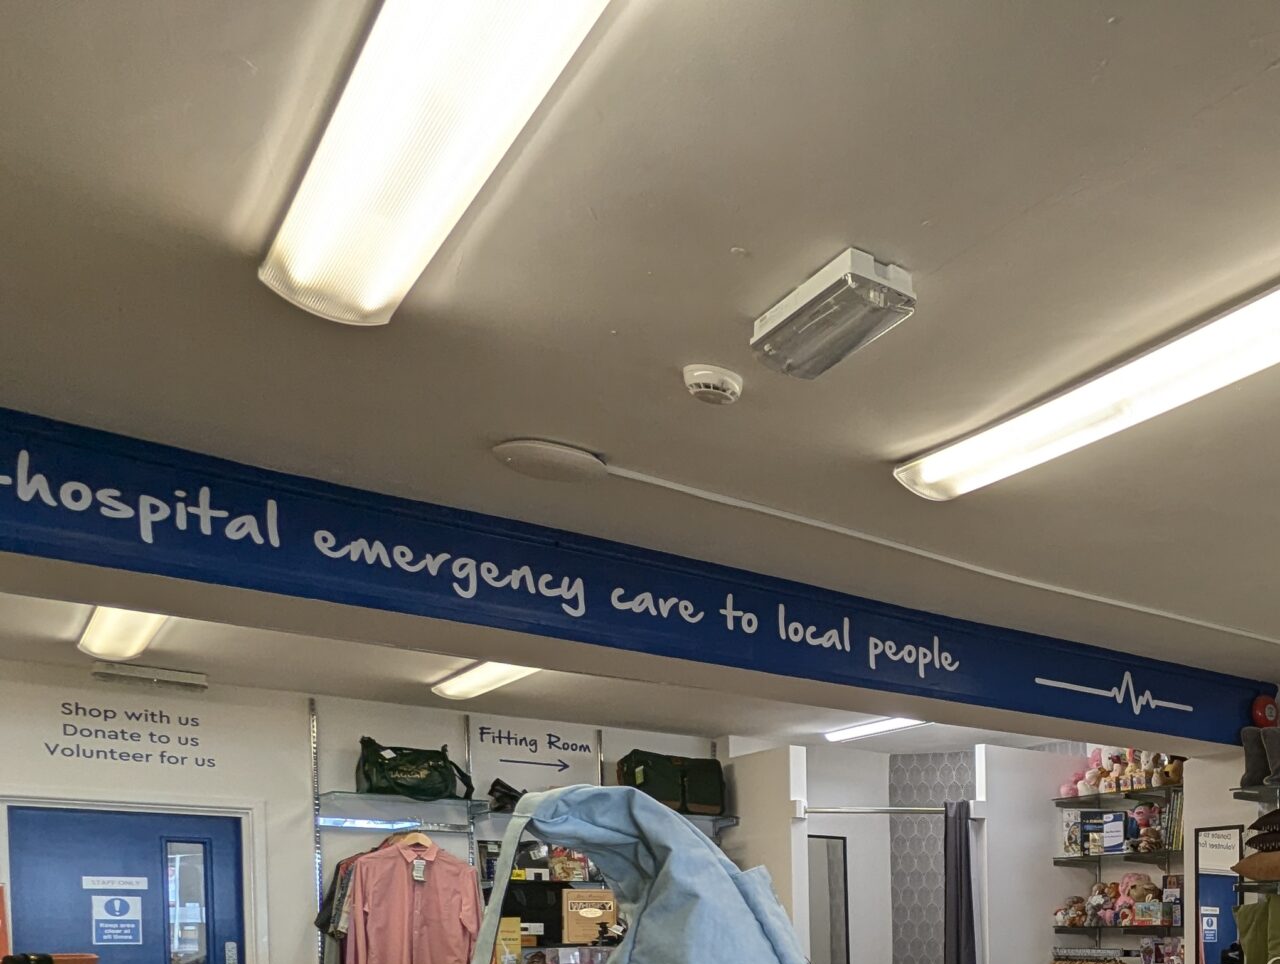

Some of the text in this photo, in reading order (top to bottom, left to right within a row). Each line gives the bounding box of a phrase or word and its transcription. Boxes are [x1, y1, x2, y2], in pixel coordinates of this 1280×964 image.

[313, 529, 586, 617] emergency
[610, 586, 704, 625] care
[719, 593, 759, 635] to
[777, 603, 851, 653] local
[867, 633, 960, 679] people
[60, 701, 201, 728] Shop with us
[61, 722, 201, 748] Donate to us
[479, 726, 592, 753] Fitting Room
[43, 742, 217, 770] Volunteer for us
